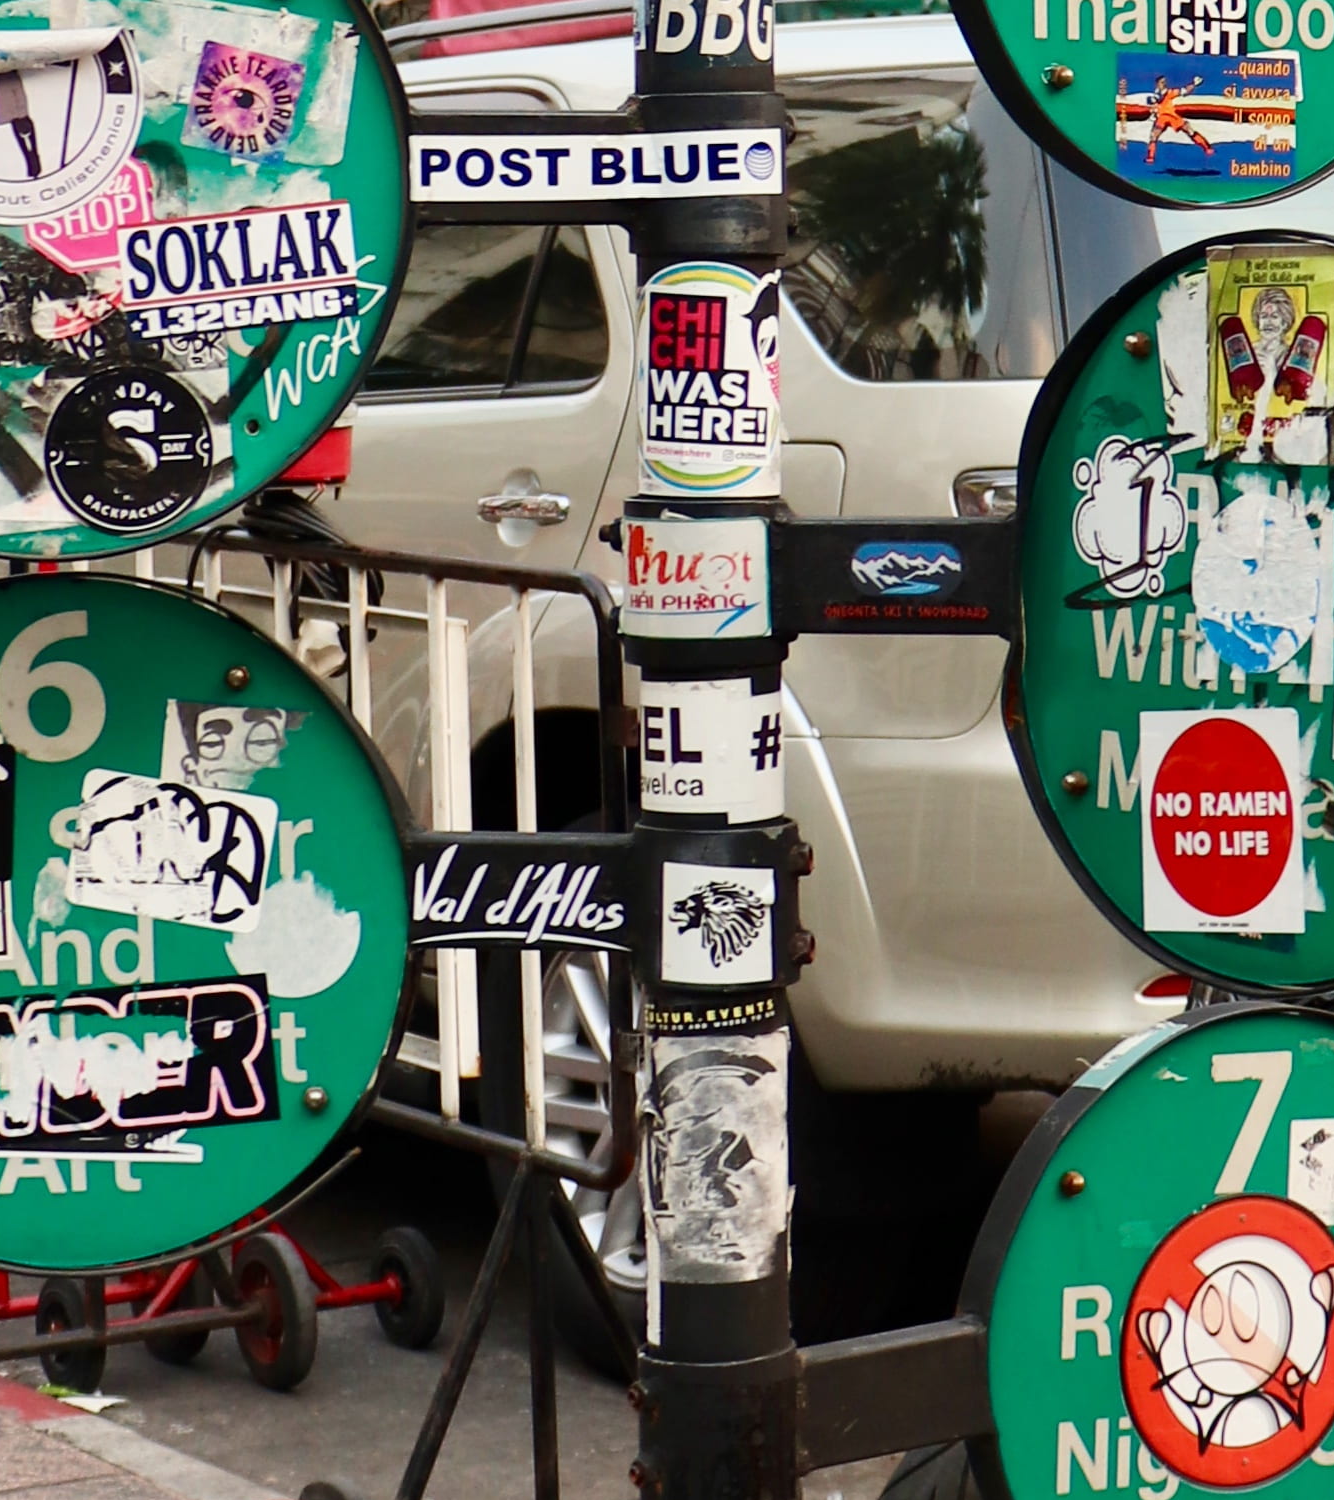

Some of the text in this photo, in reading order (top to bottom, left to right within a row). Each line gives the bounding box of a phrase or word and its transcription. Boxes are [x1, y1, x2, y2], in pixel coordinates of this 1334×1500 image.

[1169, 17, 1247, 57] SHT
[194, 55, 293, 154] FRANKIE TEARDROP DEAD
[1223, 82, 1292, 102] si avvera
[1233, 109, 1292, 129] il sogno
[39, 103, 125, 203] Calisthenics
[1253, 135, 1292, 153] di un
[419, 142, 741, 188] POST BLUE
[1230, 158, 1292, 178] bambino
[40, 196, 135, 239] SHOP
[126, 208, 350, 299] SOKLAK
[141, 288, 341, 338] 132GANG
[649, 298, 725, 334] CHI
[649, 334, 721, 371] CHI
[649, 368, 747, 409] WAS
[648, 406, 768, 444] HERE!
[1155, 790, 1287, 818] NO RAMEN
[1174, 831, 1269, 857] NO LIFE
[412, 843, 625, 945] Val d'Allos
[1210, 1051, 1293, 1195] 7
